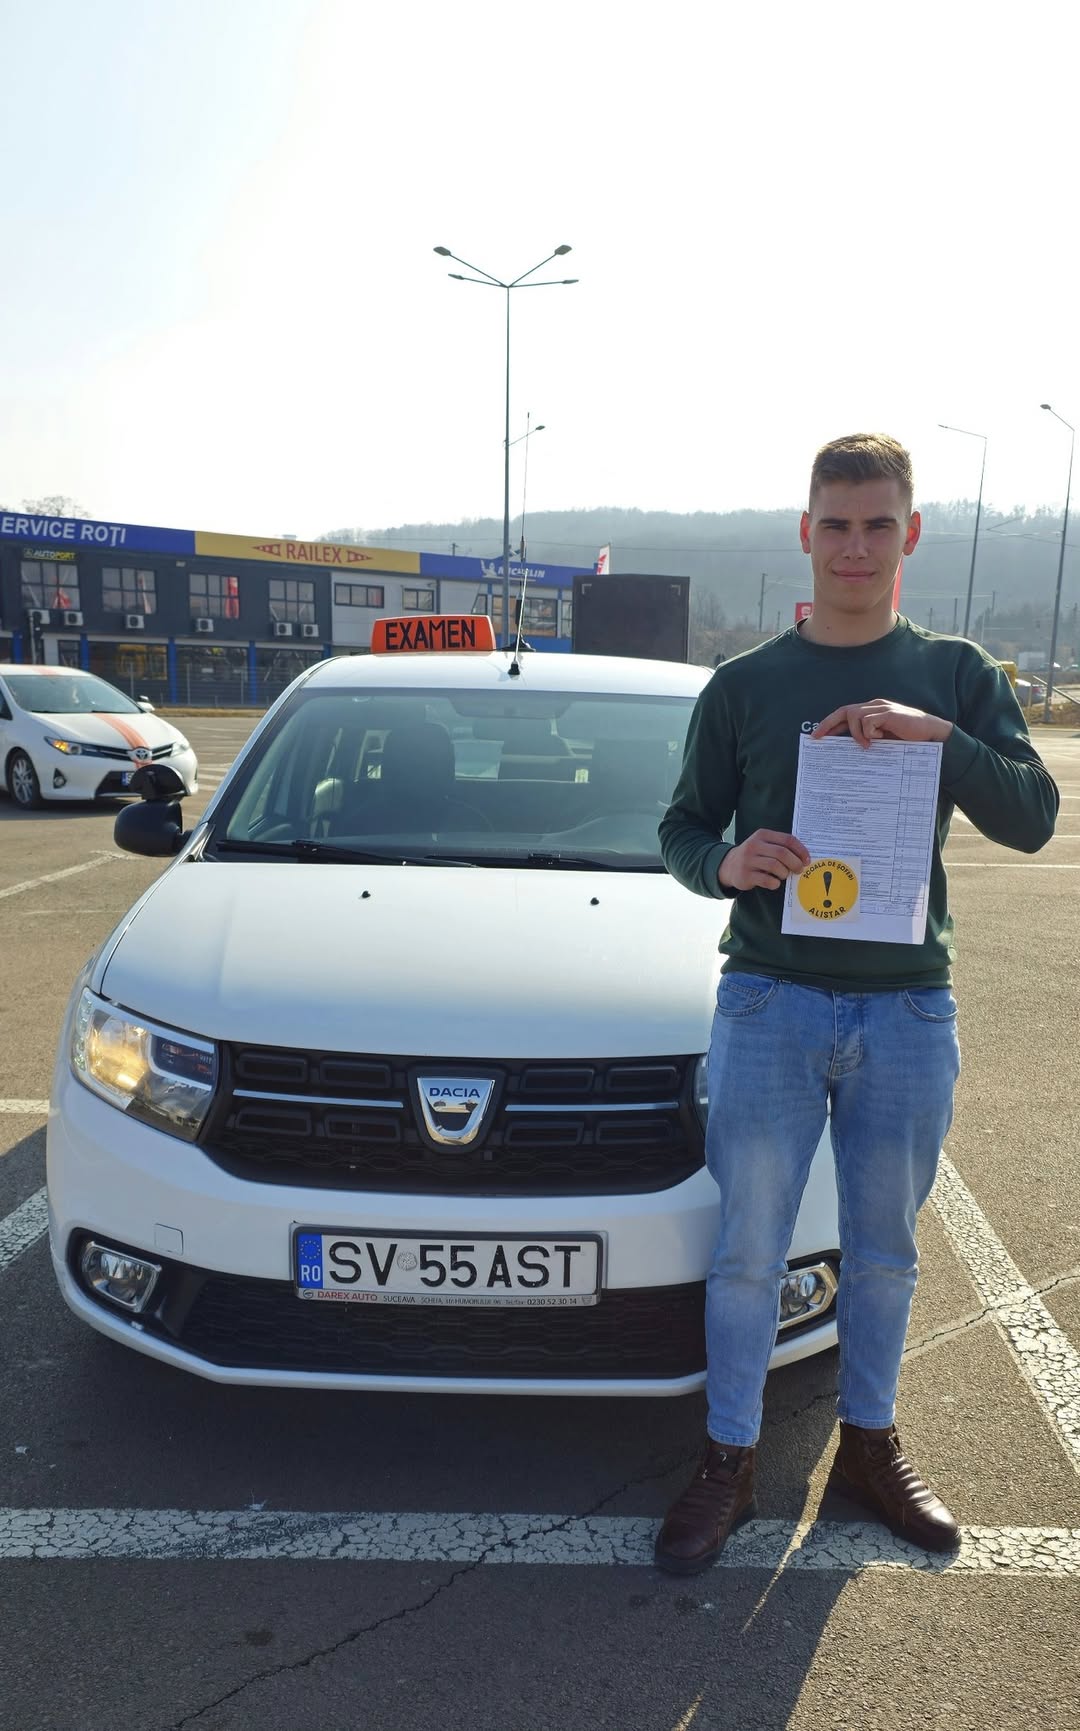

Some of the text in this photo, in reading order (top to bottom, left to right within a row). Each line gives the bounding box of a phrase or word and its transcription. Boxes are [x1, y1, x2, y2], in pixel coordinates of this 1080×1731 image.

[0, 516, 76, 539] ERVICE
[286, 543, 342, 563] RAILEX
[498, 566, 545, 578] MICLIN
[385, 620, 476, 650] EXAMEN
[801, 721, 820, 732] Ca
[809, 906, 846, 918] ALISTAR
[429, 1087, 480, 1098] DACIA
[301, 1265, 320, 1282] RO
[317, 1291, 349, 1300] DAREX
[351, 1292, 378, 1301] AUTO
[383, 1295, 416, 1303] SUCEAVA
